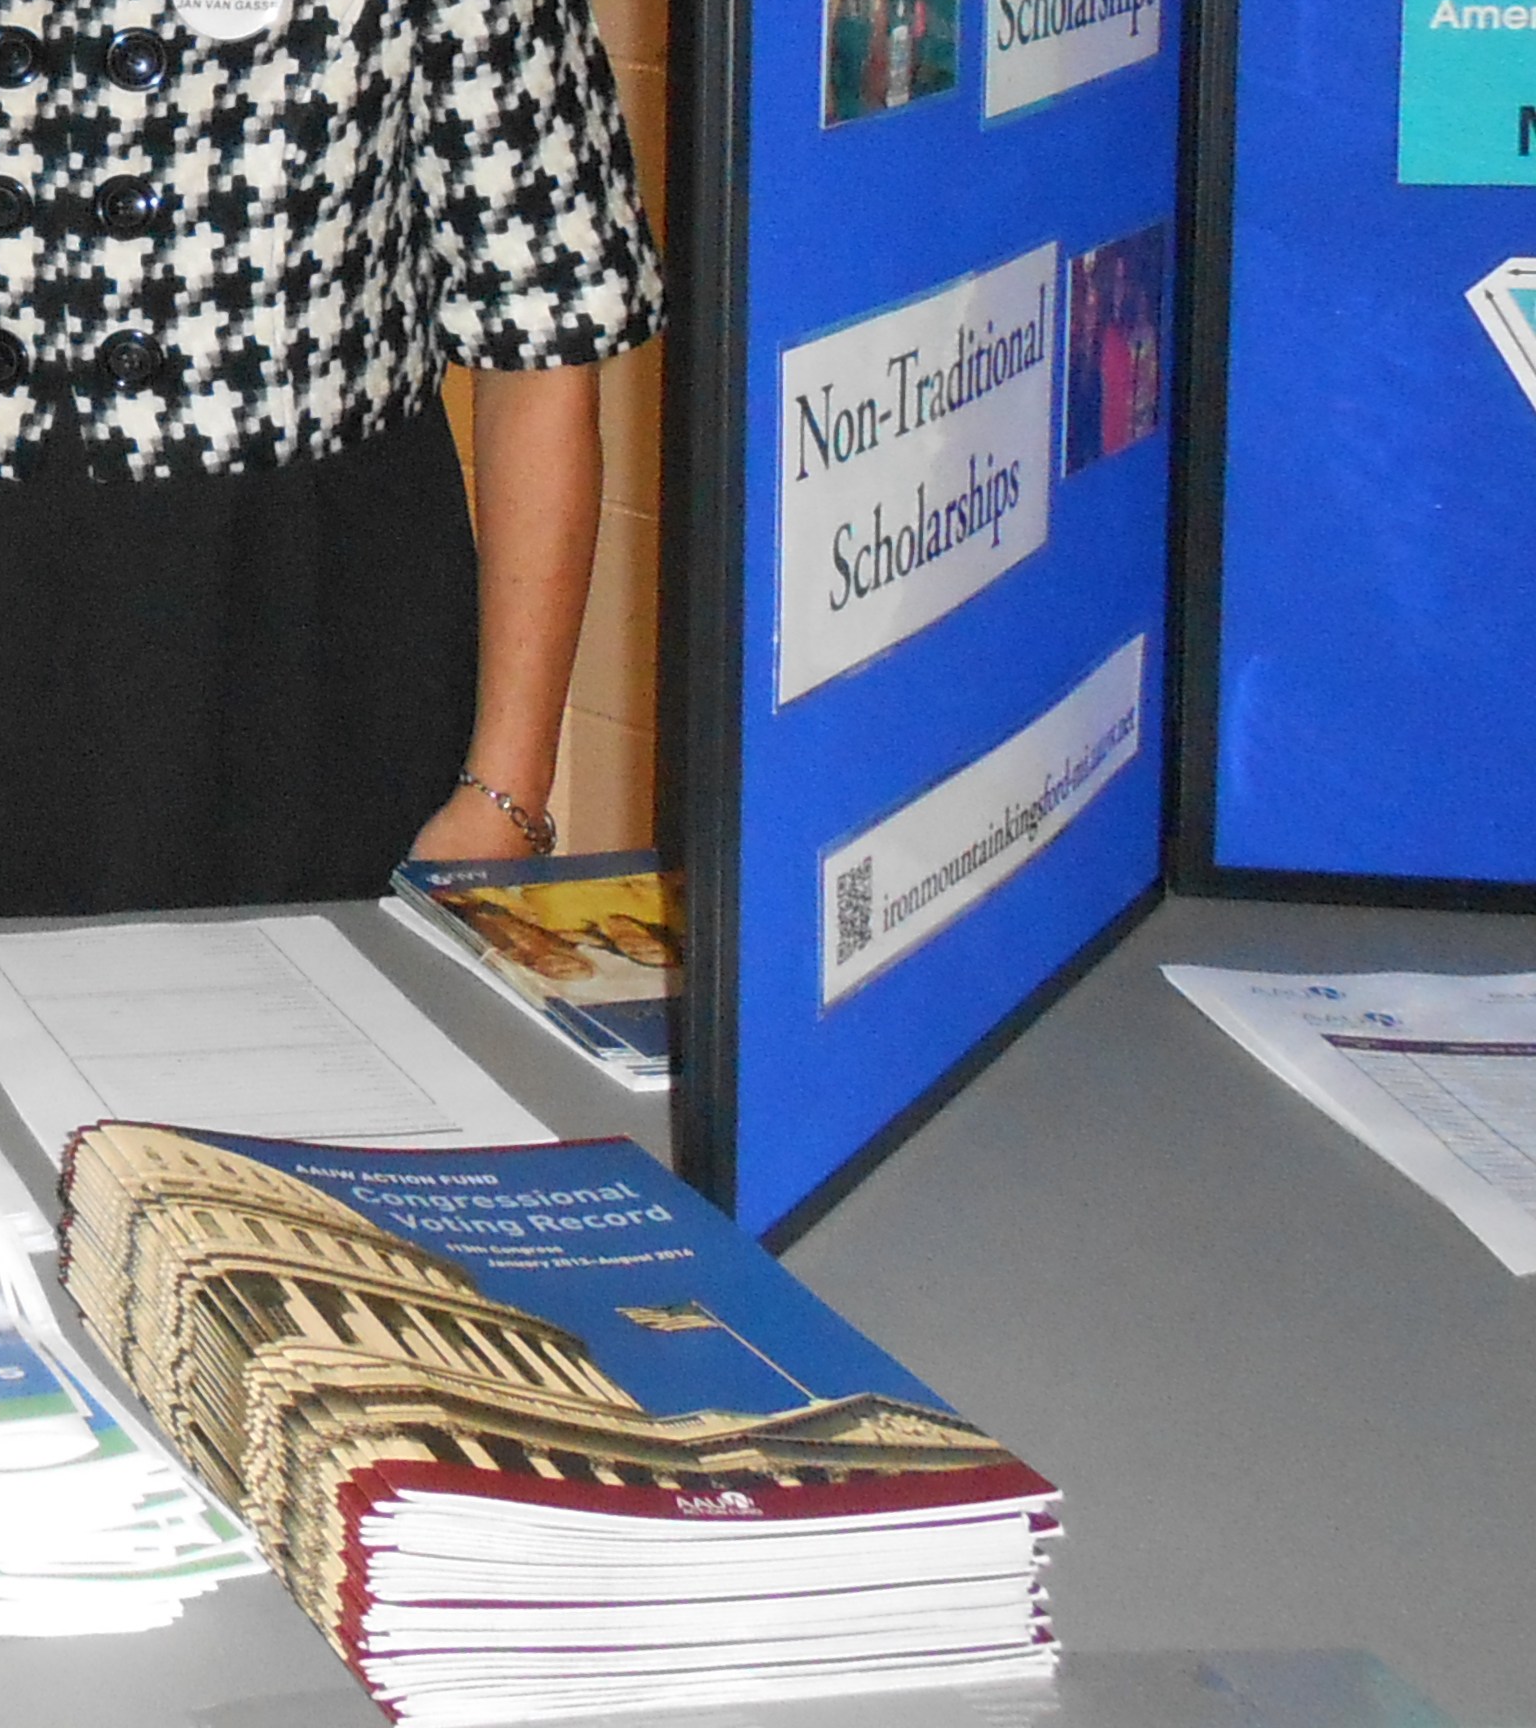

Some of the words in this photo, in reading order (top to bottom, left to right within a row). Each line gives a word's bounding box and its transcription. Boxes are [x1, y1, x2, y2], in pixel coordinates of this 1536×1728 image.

[177, 0, 201, 9] JAN
[206, 0, 231, 10] VAN
[794, 283, 1046, 482] Non-Traditional
[830, 459, 1020, 611] Scholarships
[295, 1163, 356, 1181] AAUW
[361, 1171, 437, 1186] ACTION
[438, 1173, 499, 1186] FUND
[351, 1181, 640, 1213] Congressional
[388, 1210, 525, 1237] Voting
[526, 1203, 674, 1233] Record
[487, 1258, 550, 1270] January
[655, 1247, 696, 1261] 2014
[490, 1245, 565, 1256] Congress
